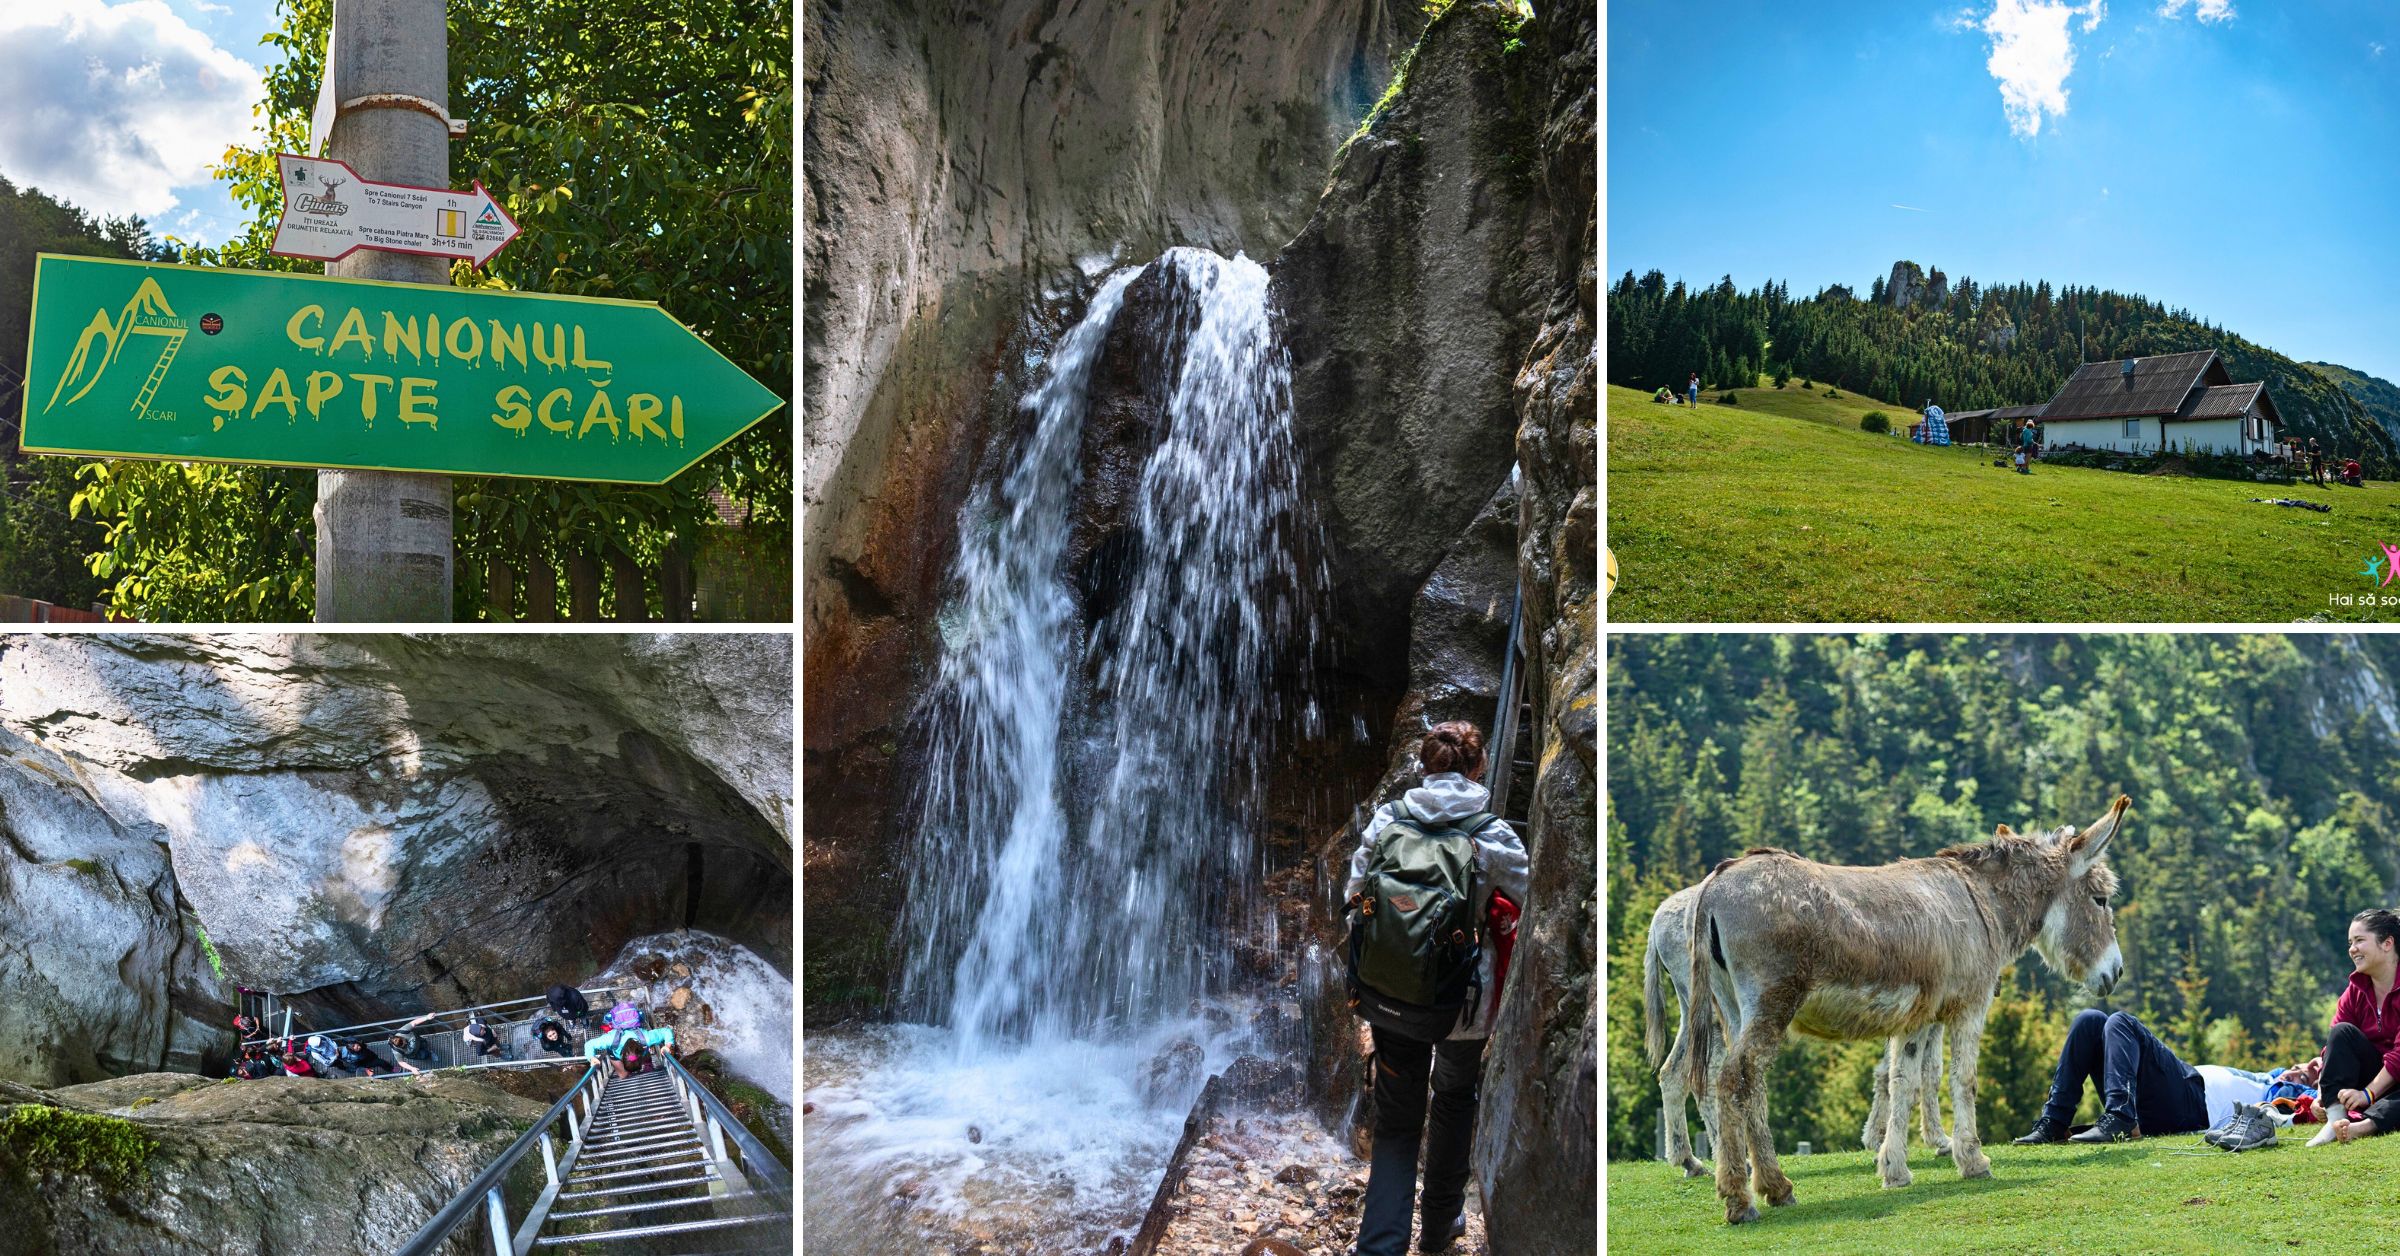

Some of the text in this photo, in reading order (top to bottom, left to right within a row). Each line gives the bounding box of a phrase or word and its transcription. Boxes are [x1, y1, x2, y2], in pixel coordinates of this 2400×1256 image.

[364, 188, 378, 196] Spre
[380, 190, 406, 199] Canionul
[382, 199, 399, 207] Stairs
[400, 201, 423, 210] Canyon
[448, 199, 457, 207] 1h
[358, 225, 373, 234] Spre
[373, 227, 395, 236] cabana
[396, 230, 413, 238] Piatra
[374, 236, 384, 244] Big
[431, 237, 456, 248] 3h+15
[135, 315, 188, 329] CANIONUL
[286, 304, 614, 375] CANIONUL
[203, 365, 686, 449] ȘAPTE SCĂRI
[146, 410, 177, 421] SCARI
